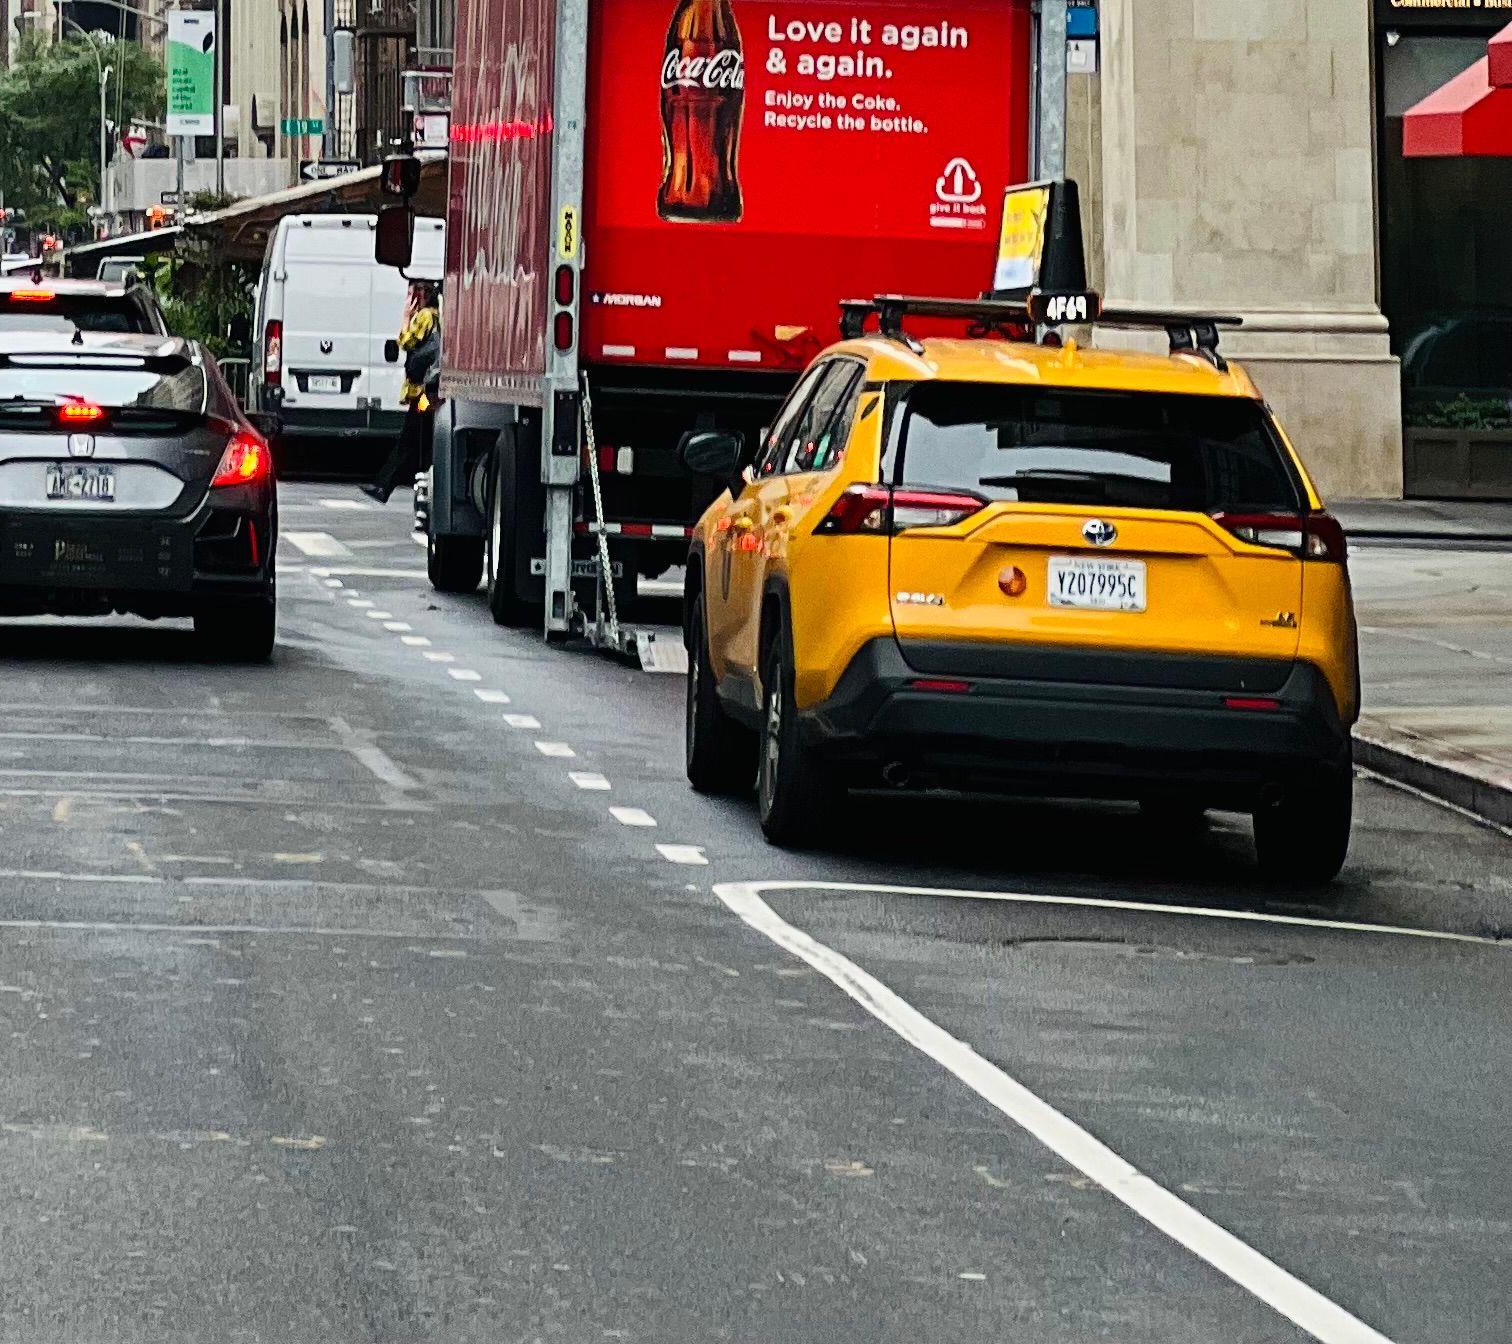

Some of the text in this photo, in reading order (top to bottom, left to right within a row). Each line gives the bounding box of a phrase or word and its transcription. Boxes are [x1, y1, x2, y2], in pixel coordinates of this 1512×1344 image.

[768, 14, 969, 52] Love it again
[661, 48, 745, 89] Coca-Cola
[765, 47, 893, 81] & again.
[764, 89, 901, 112] Enjoy the Coke.
[764, 110, 929, 134] Recycle the bottle.
[929, 202, 987, 215] give it back
[602, 293, 662, 308] MORGAN
[1046, 295, 1087, 321] 4F69
[1057, 571, 1137, 599] Y207995C
